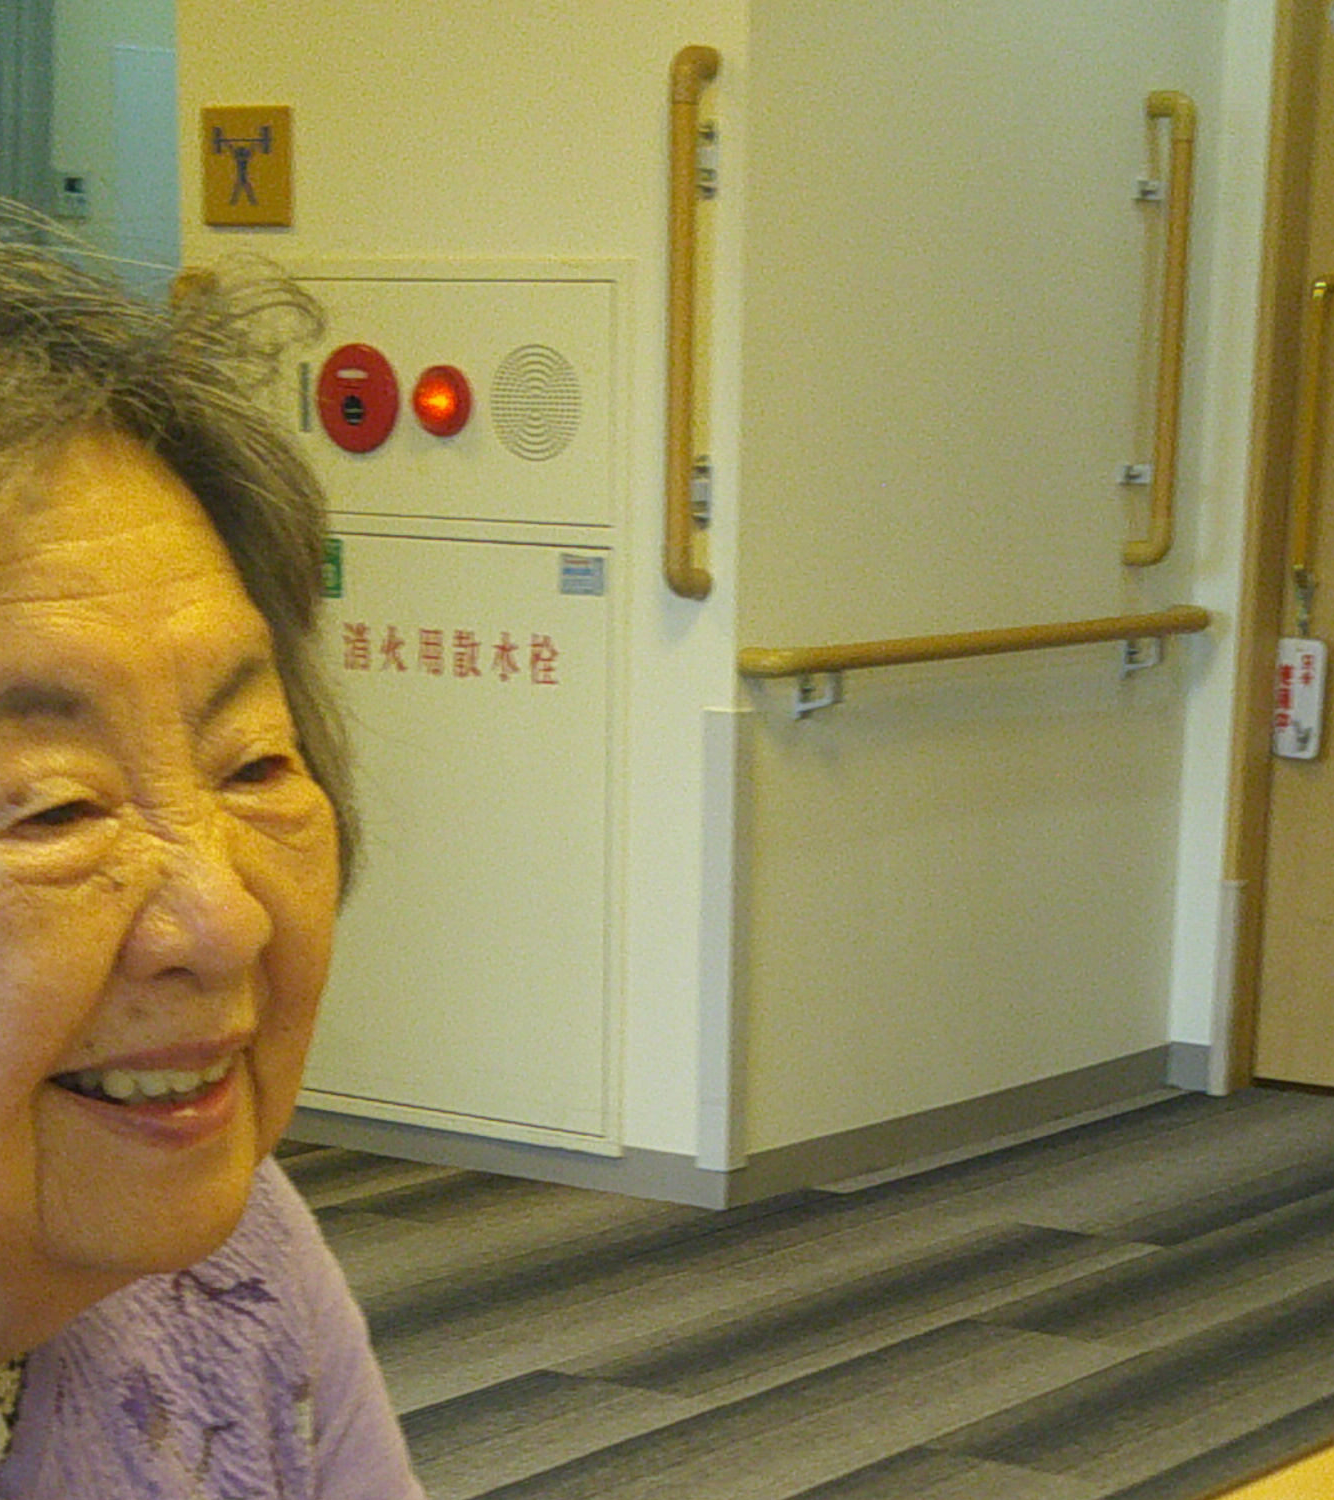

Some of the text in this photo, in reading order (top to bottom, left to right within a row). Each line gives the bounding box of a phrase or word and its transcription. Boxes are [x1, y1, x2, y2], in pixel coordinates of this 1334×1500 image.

[342, 621, 560, 685] 消火用散水栓
